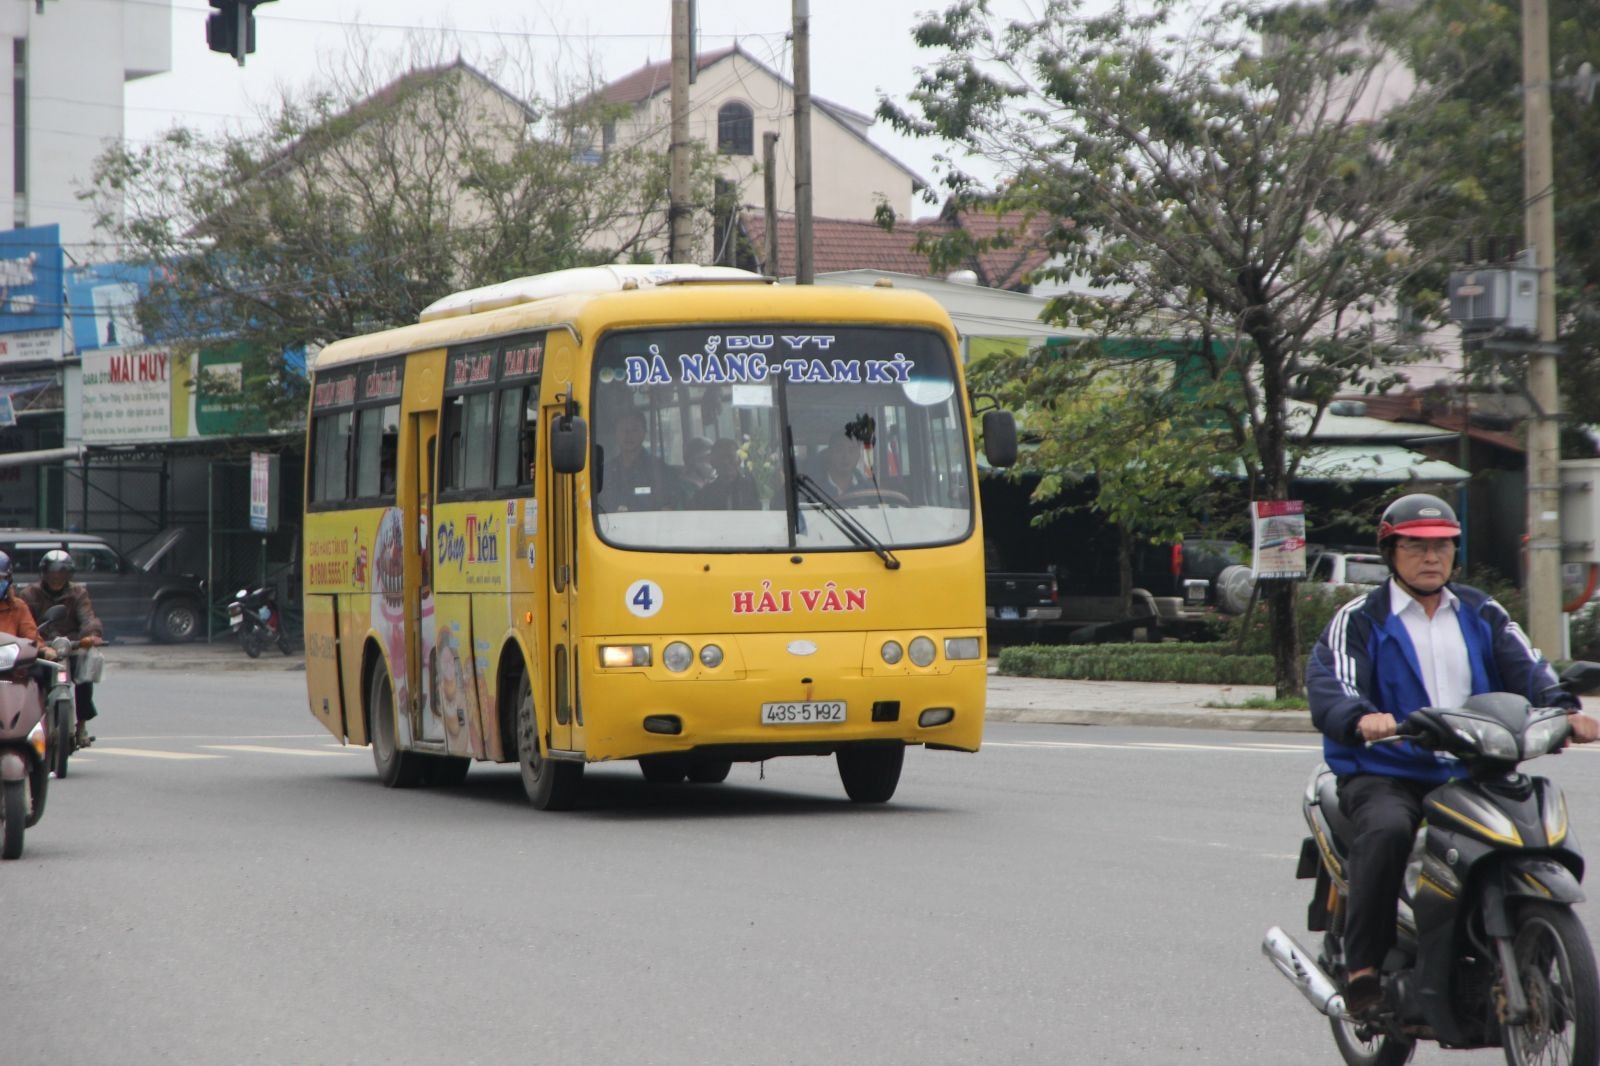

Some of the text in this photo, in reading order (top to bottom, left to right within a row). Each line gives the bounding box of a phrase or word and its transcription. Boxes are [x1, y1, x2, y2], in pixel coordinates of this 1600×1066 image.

[726, 335, 835, 349] BU YT
[111, 356, 134, 384] MAI
[139, 352, 167, 382] HUY
[625, 344, 672, 385] ĐÀ
[865, 352, 915, 383] KỲ
[633, 584, 653, 610] 4
[732, 580, 866, 613] HẢI VÂN
